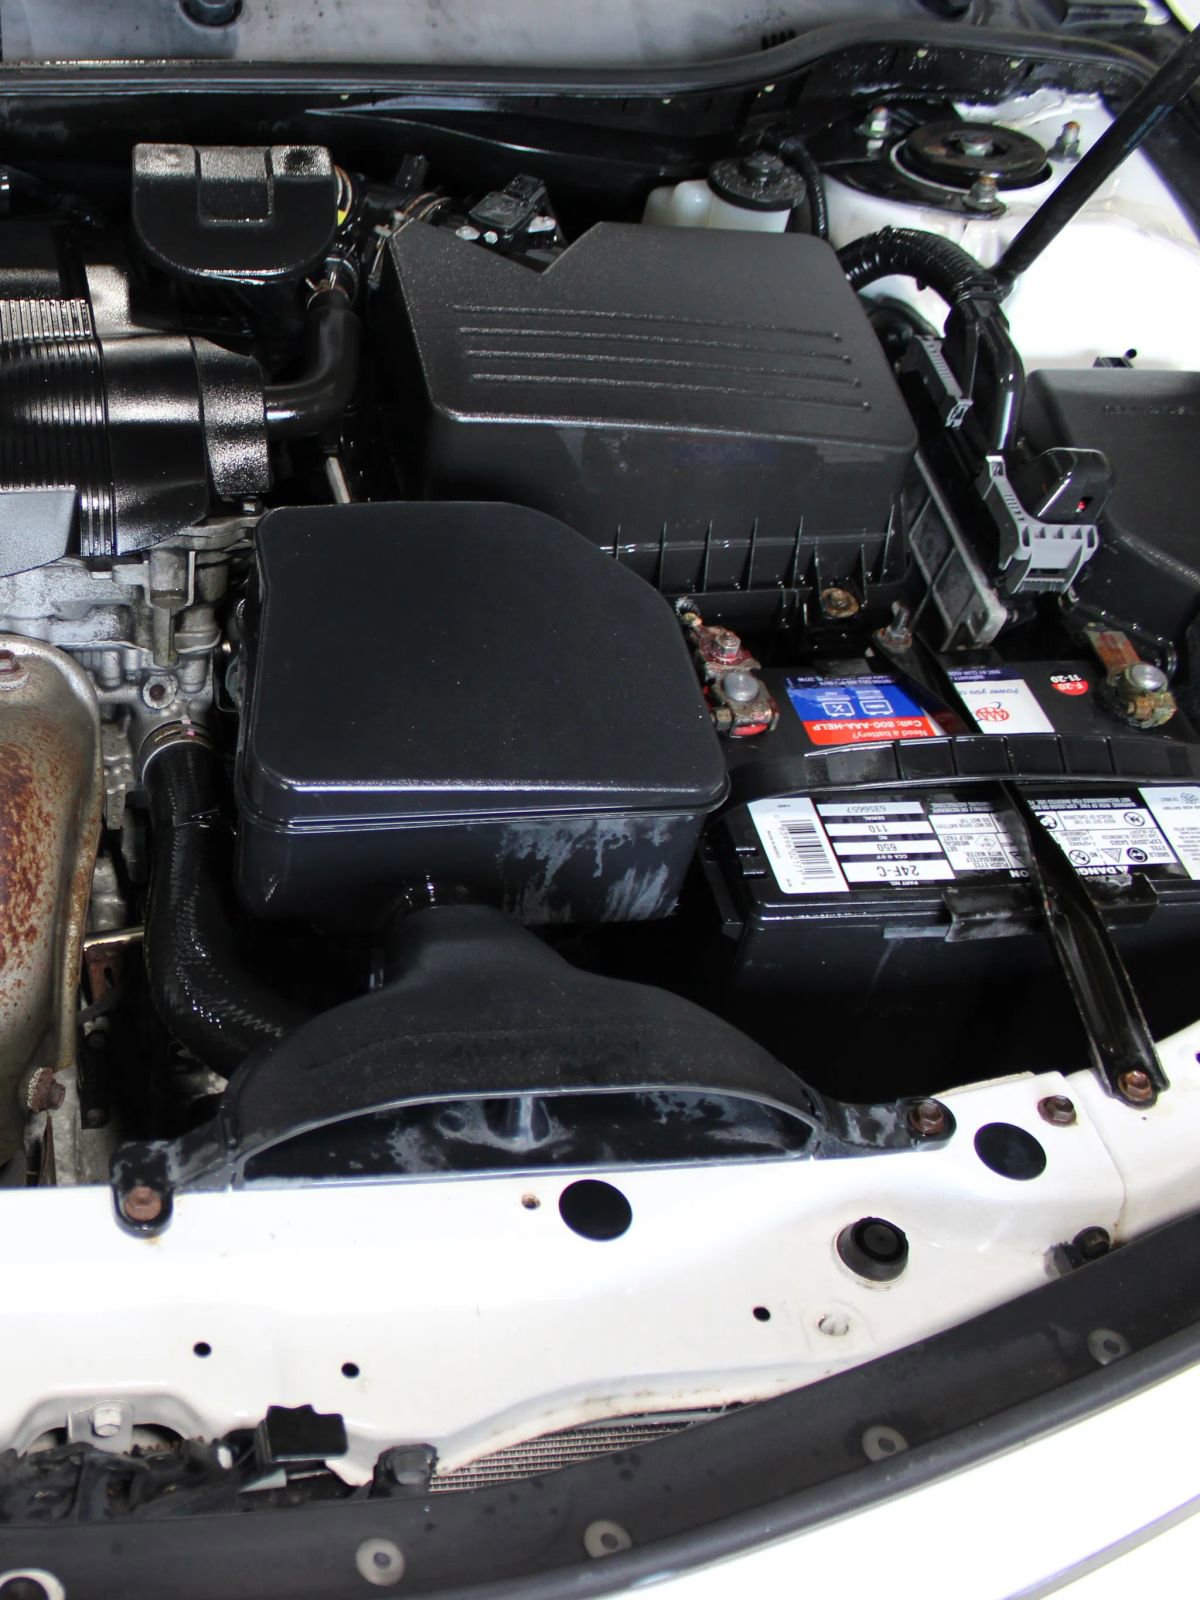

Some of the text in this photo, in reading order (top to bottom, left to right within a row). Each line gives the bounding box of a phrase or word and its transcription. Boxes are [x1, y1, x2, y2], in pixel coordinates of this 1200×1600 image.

[1050, 674, 1082, 682] 11-20
[980, 711, 1005, 720] AAA
[813, 721, 895, 730] 800-AAA-HELP
[853, 731, 891, 739] battery?
[868, 825, 887, 833] 110
[877, 865, 919, 877] 24F-C
